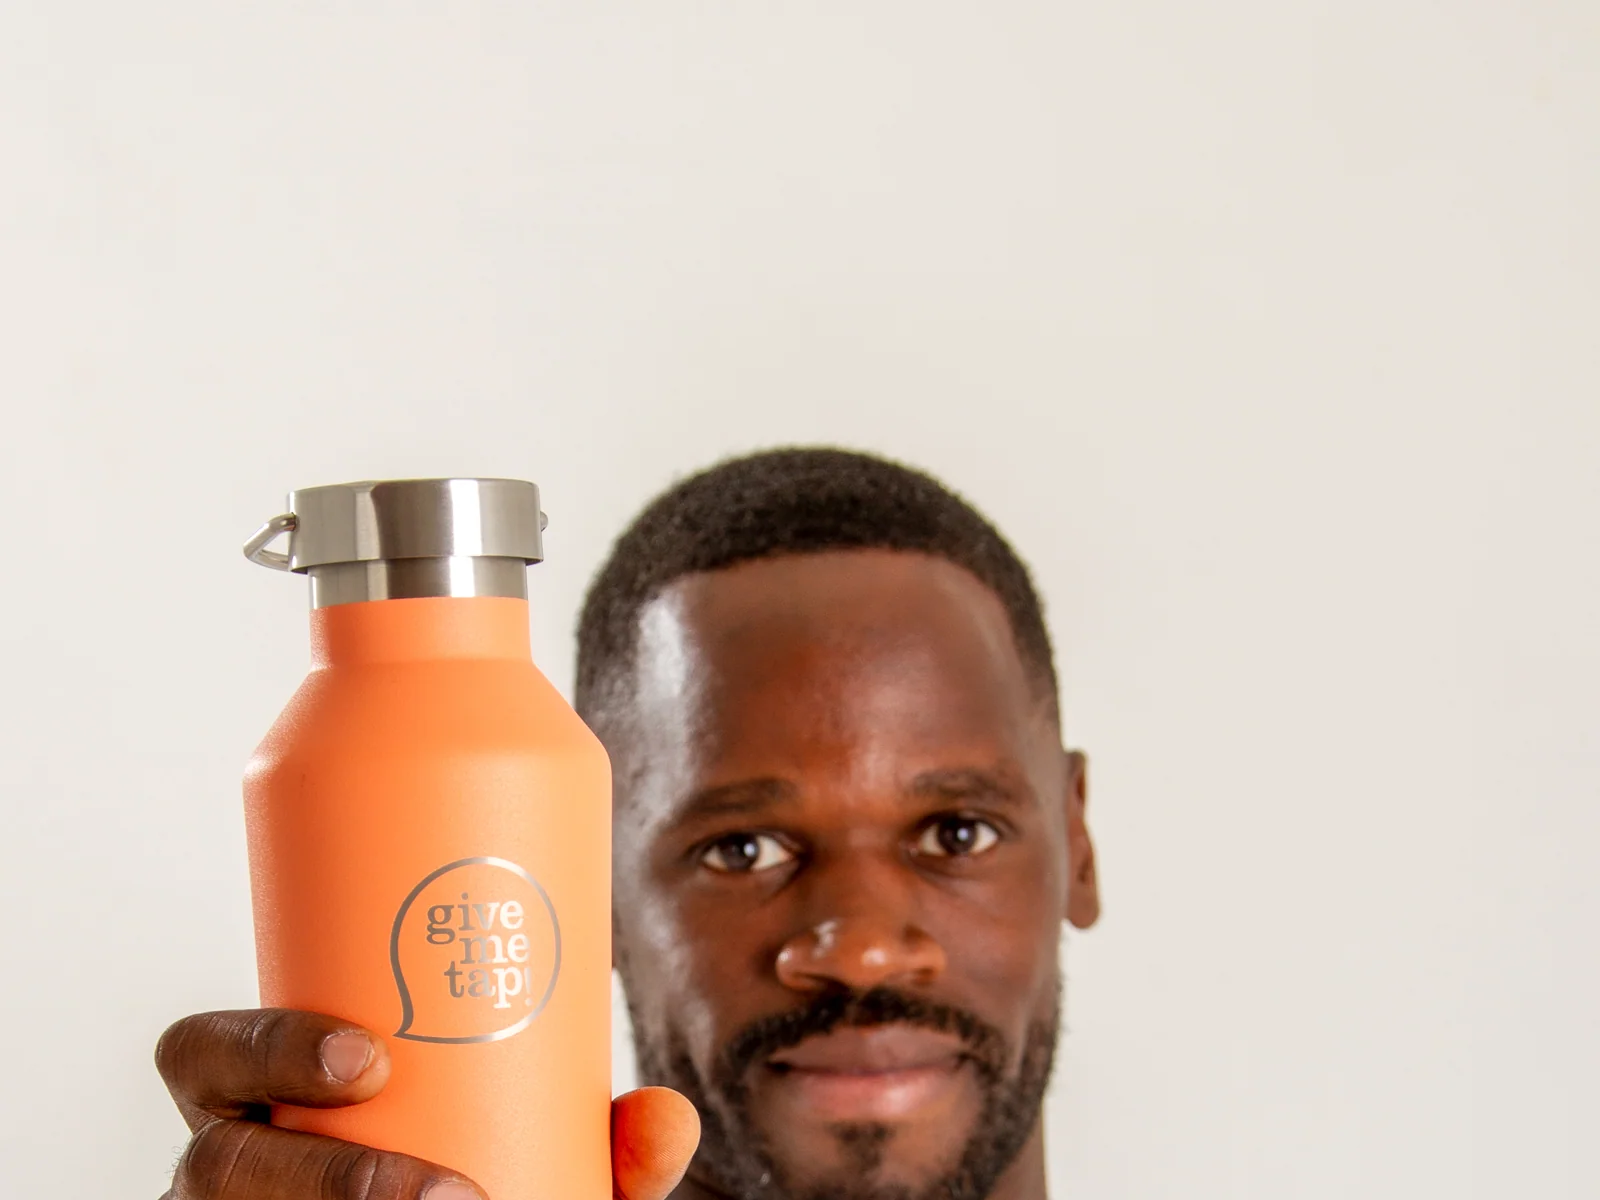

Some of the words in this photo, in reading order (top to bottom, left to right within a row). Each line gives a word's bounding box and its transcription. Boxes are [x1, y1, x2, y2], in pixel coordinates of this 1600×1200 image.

[426, 892, 524, 945] give
[459, 933, 531, 964] me
[444, 960, 533, 1009] tap!
